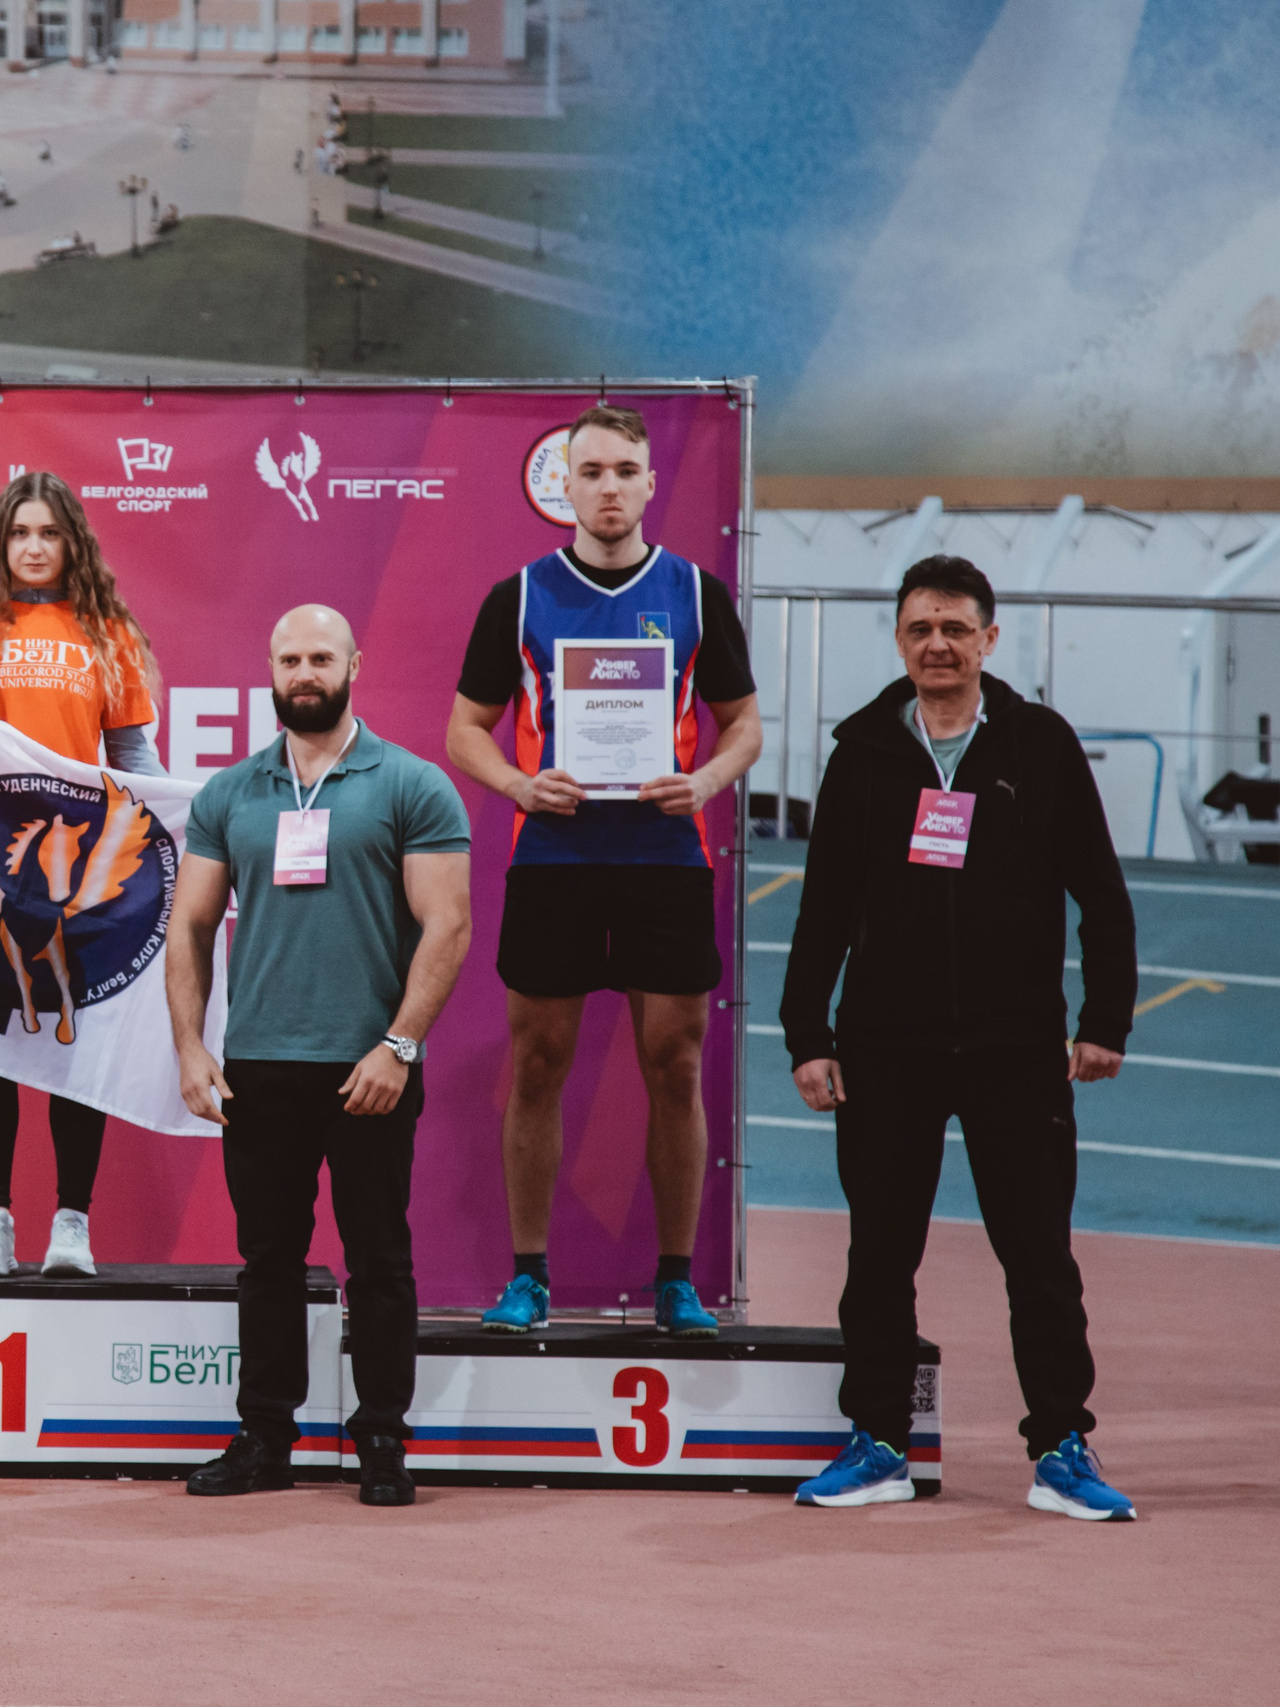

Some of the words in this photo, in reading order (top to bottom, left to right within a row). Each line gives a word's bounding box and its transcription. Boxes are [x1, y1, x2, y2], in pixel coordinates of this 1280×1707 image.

[80, 484, 209, 499] БЕЛГОРОДСКИЙ
[327, 478, 445, 499] ПЕГАС
[116, 499, 172, 512] СПОРТ
[25, 638, 56, 649] НИУ
[0, 639, 97, 672] БелГУ
[0, 666, 64, 678] BELGOROD
[66, 670, 96, 690] STATE
[0, 677, 68, 690] UNIVERSITY
[585, 699, 644, 711] ДИПЛОМ
[155, 838, 177, 934] СПОРТИВНЫЙ
[131, 934, 162, 972] КЛУБ
[175, 1345, 220, 1360] НИУ
[149, 1350, 241, 1385] БелГ
[611, 1365, 671, 1467] 3
